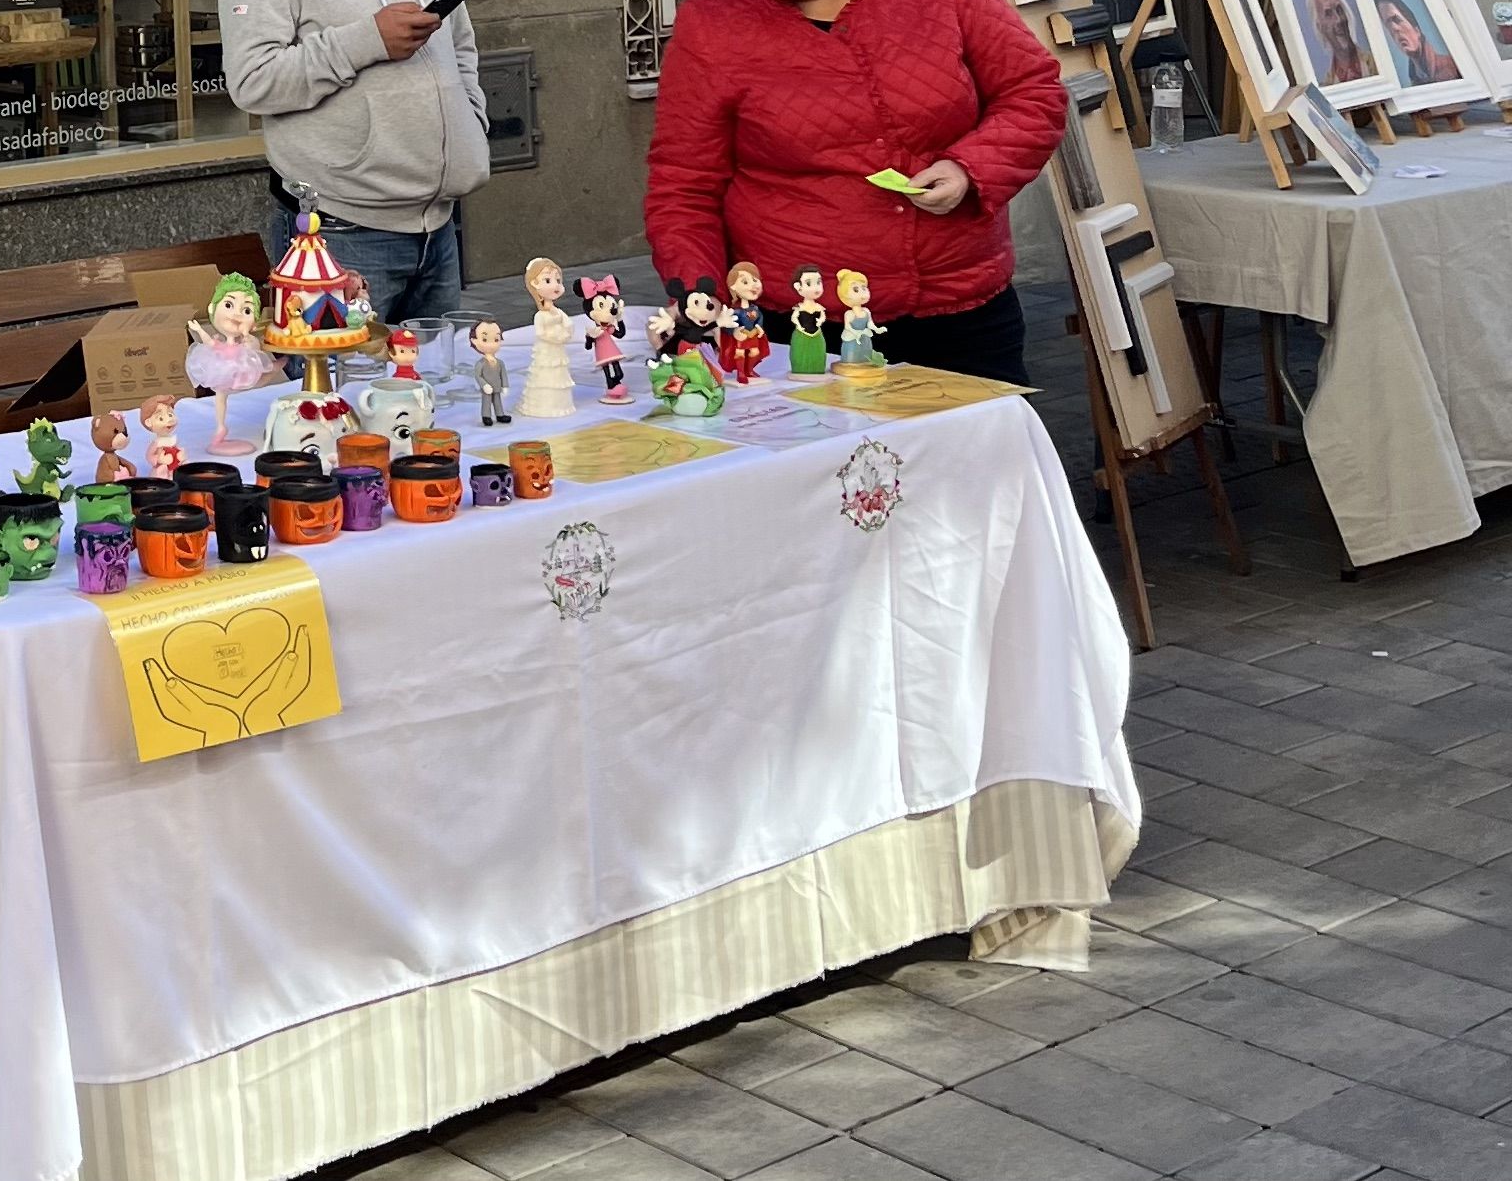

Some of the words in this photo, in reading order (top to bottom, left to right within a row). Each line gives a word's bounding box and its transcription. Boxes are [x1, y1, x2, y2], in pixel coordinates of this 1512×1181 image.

[50, 78, 179, 111] biodegradables
[191, 74, 225, 94] sost
[120, 610, 169, 631] HECHO
